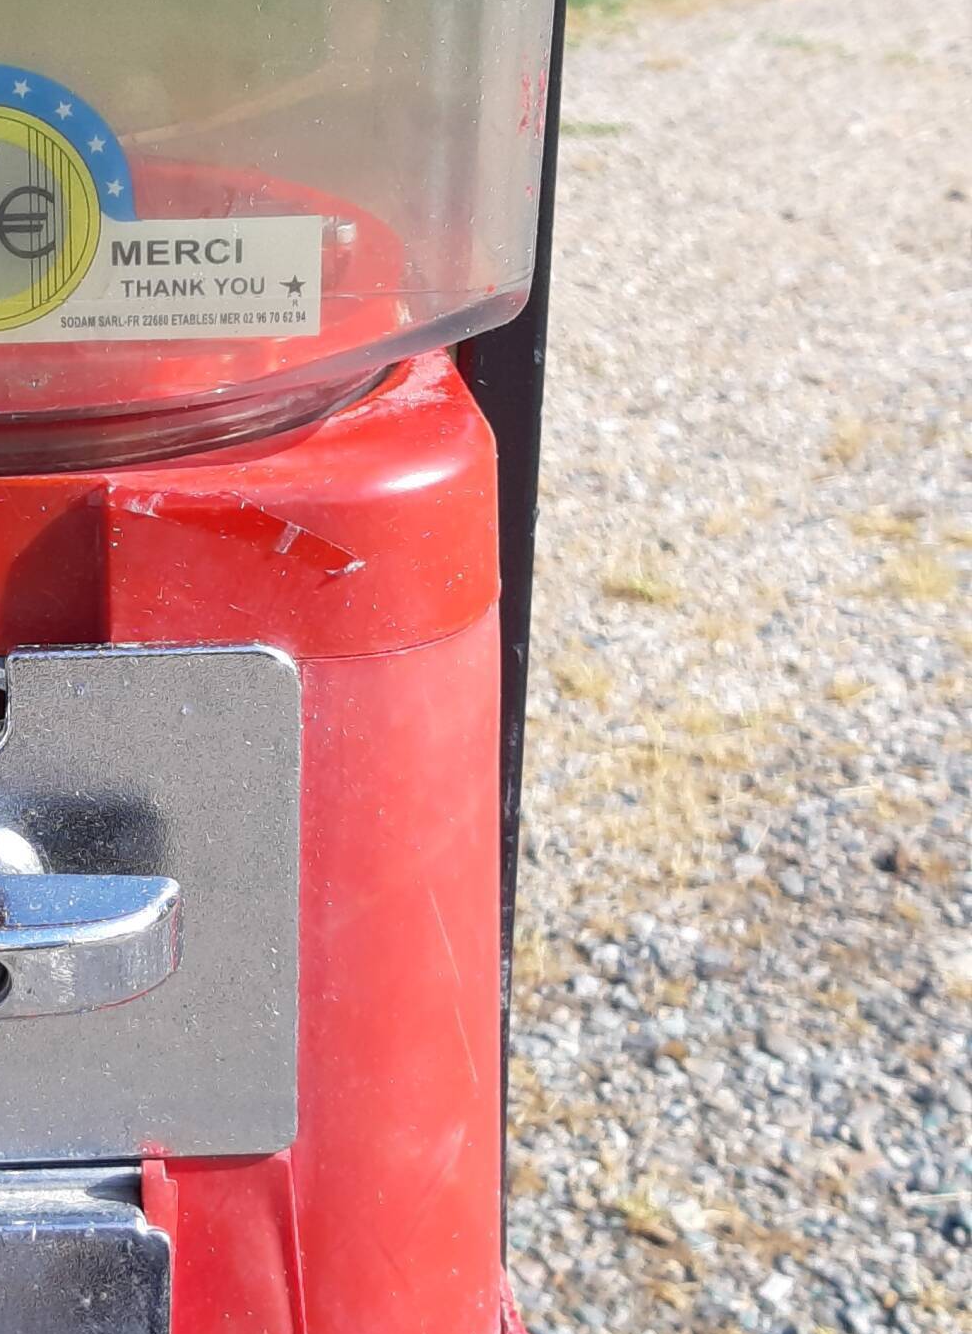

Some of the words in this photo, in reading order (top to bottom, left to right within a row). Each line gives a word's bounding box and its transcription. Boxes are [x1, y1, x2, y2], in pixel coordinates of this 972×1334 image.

[111, 238, 244, 267] MERCI
[121, 278, 207, 298] THANK
[214, 276, 266, 296] YOU
[220, 312, 241, 324] MER
[243, 313, 254, 324] 02
[256, 312, 267, 323] 96
[269, 312, 280, 323] 70
[295, 311, 307, 322] 94
